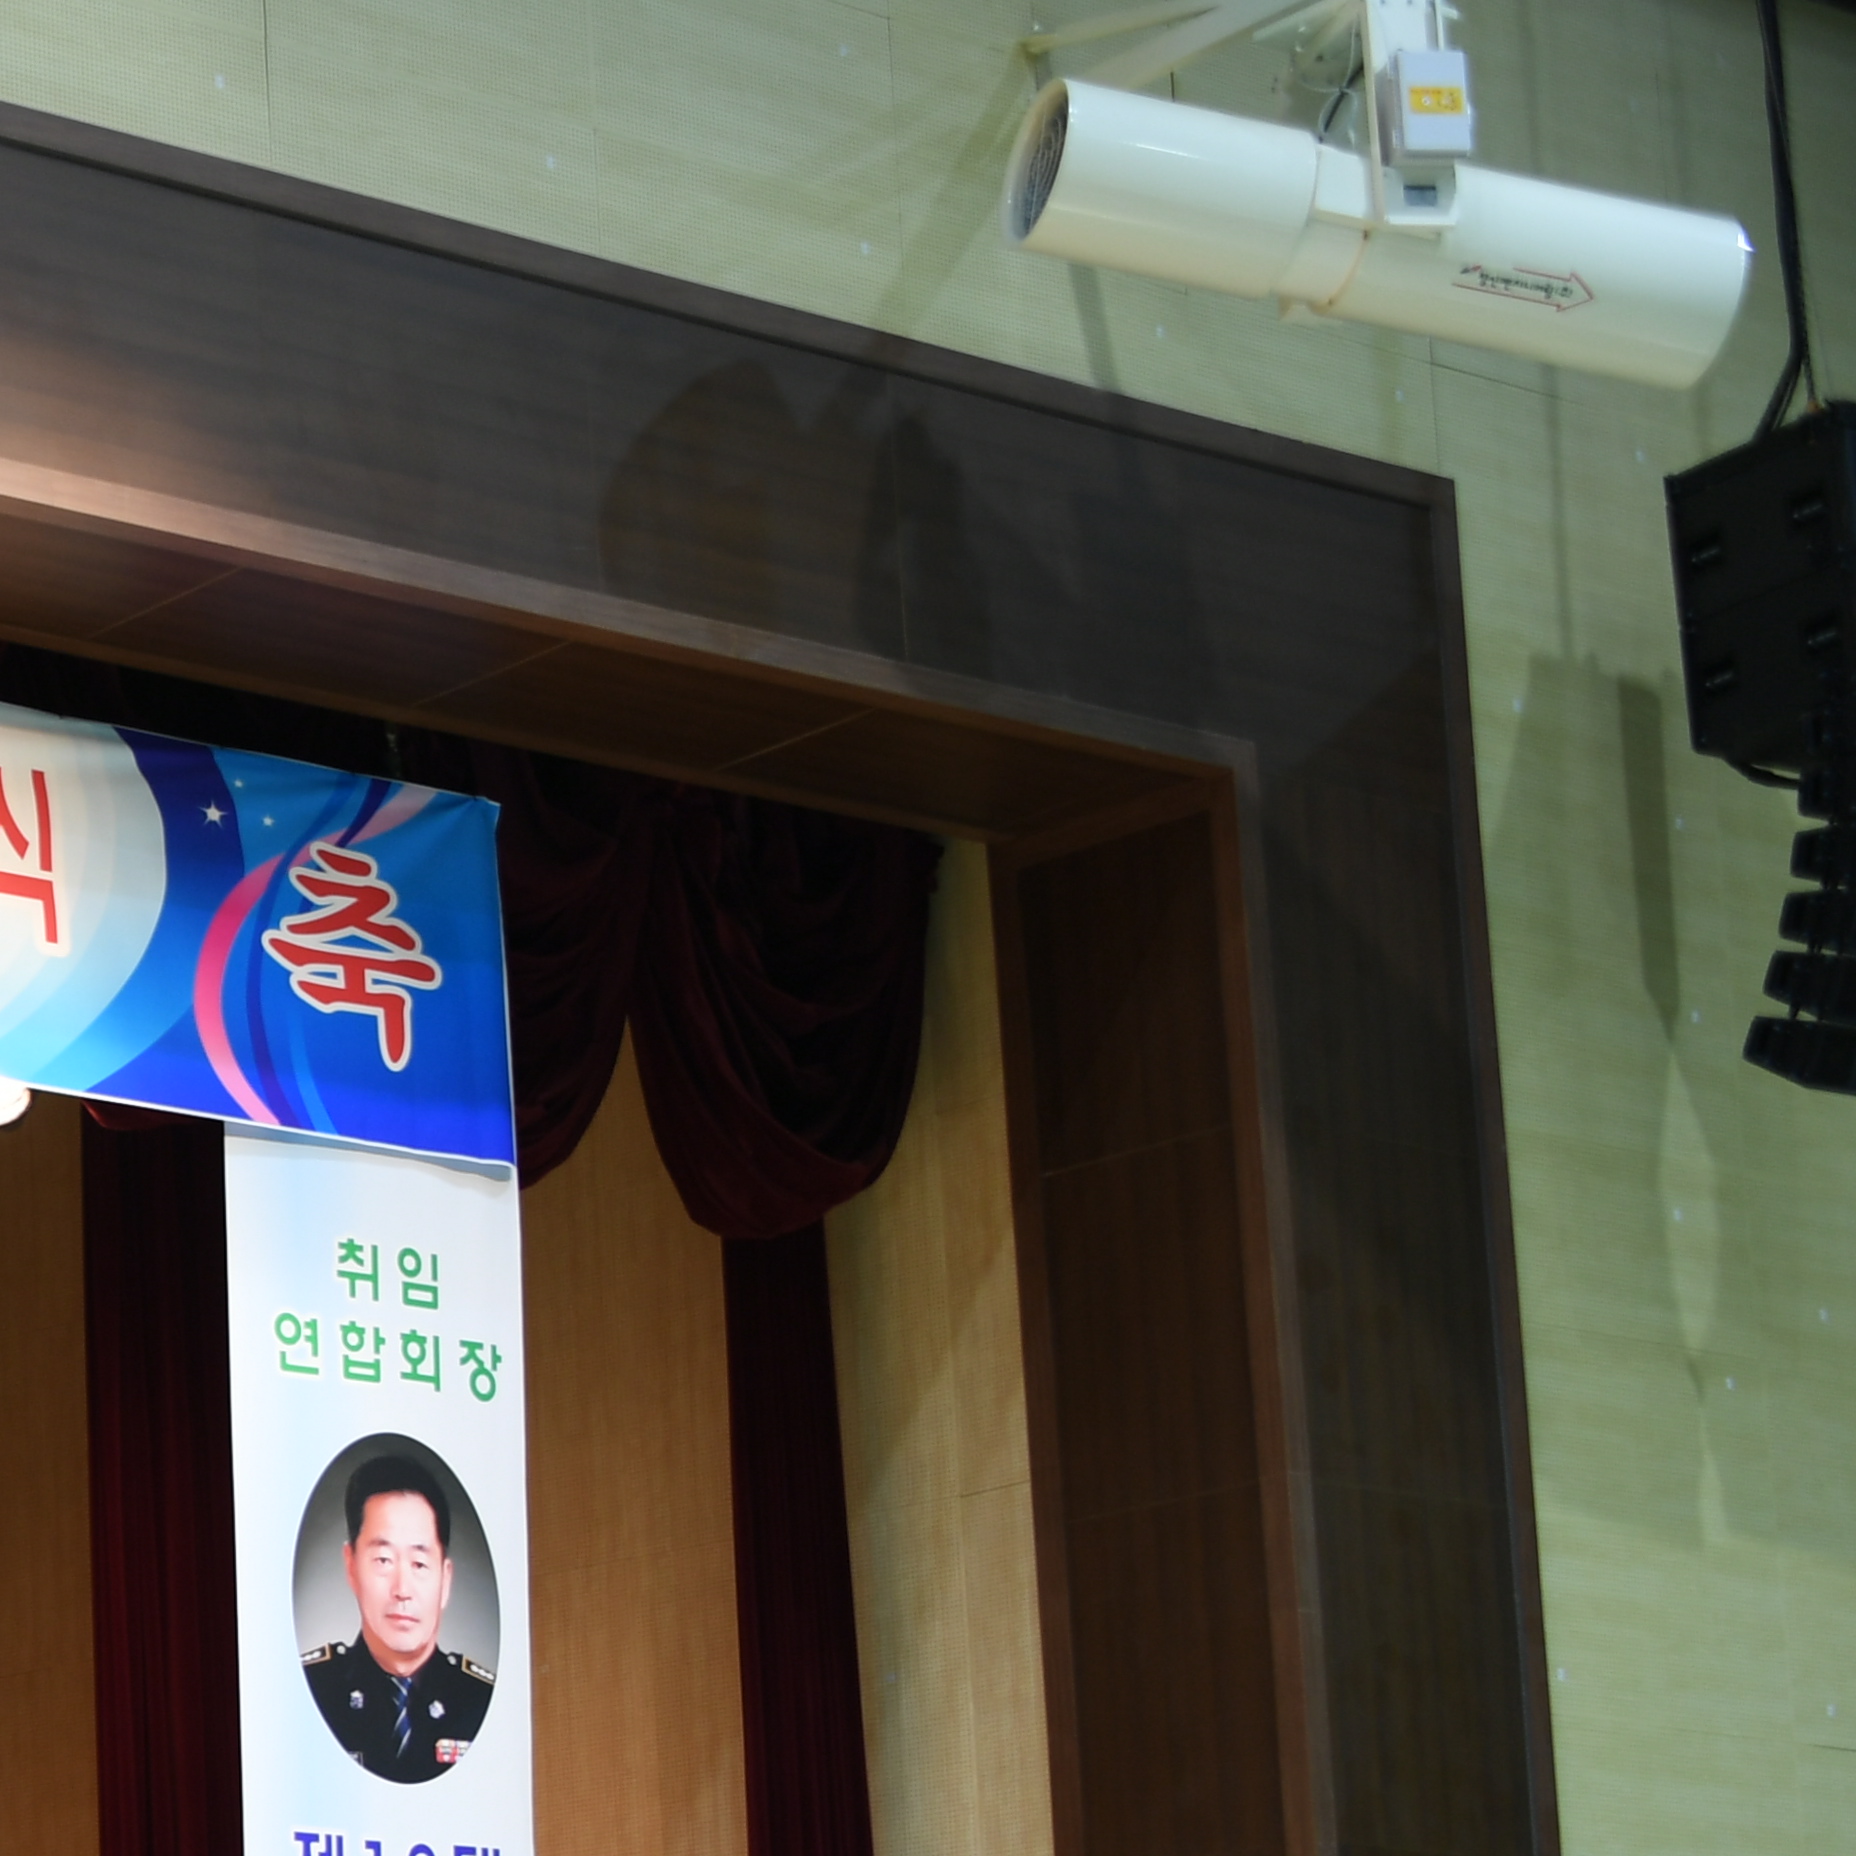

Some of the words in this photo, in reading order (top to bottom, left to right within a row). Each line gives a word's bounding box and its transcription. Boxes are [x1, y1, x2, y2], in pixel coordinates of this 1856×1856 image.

[266, 845, 438, 1067] 축
[336, 1238, 440, 1311] 취임
[274, 1312, 503, 1403] 연합회장
